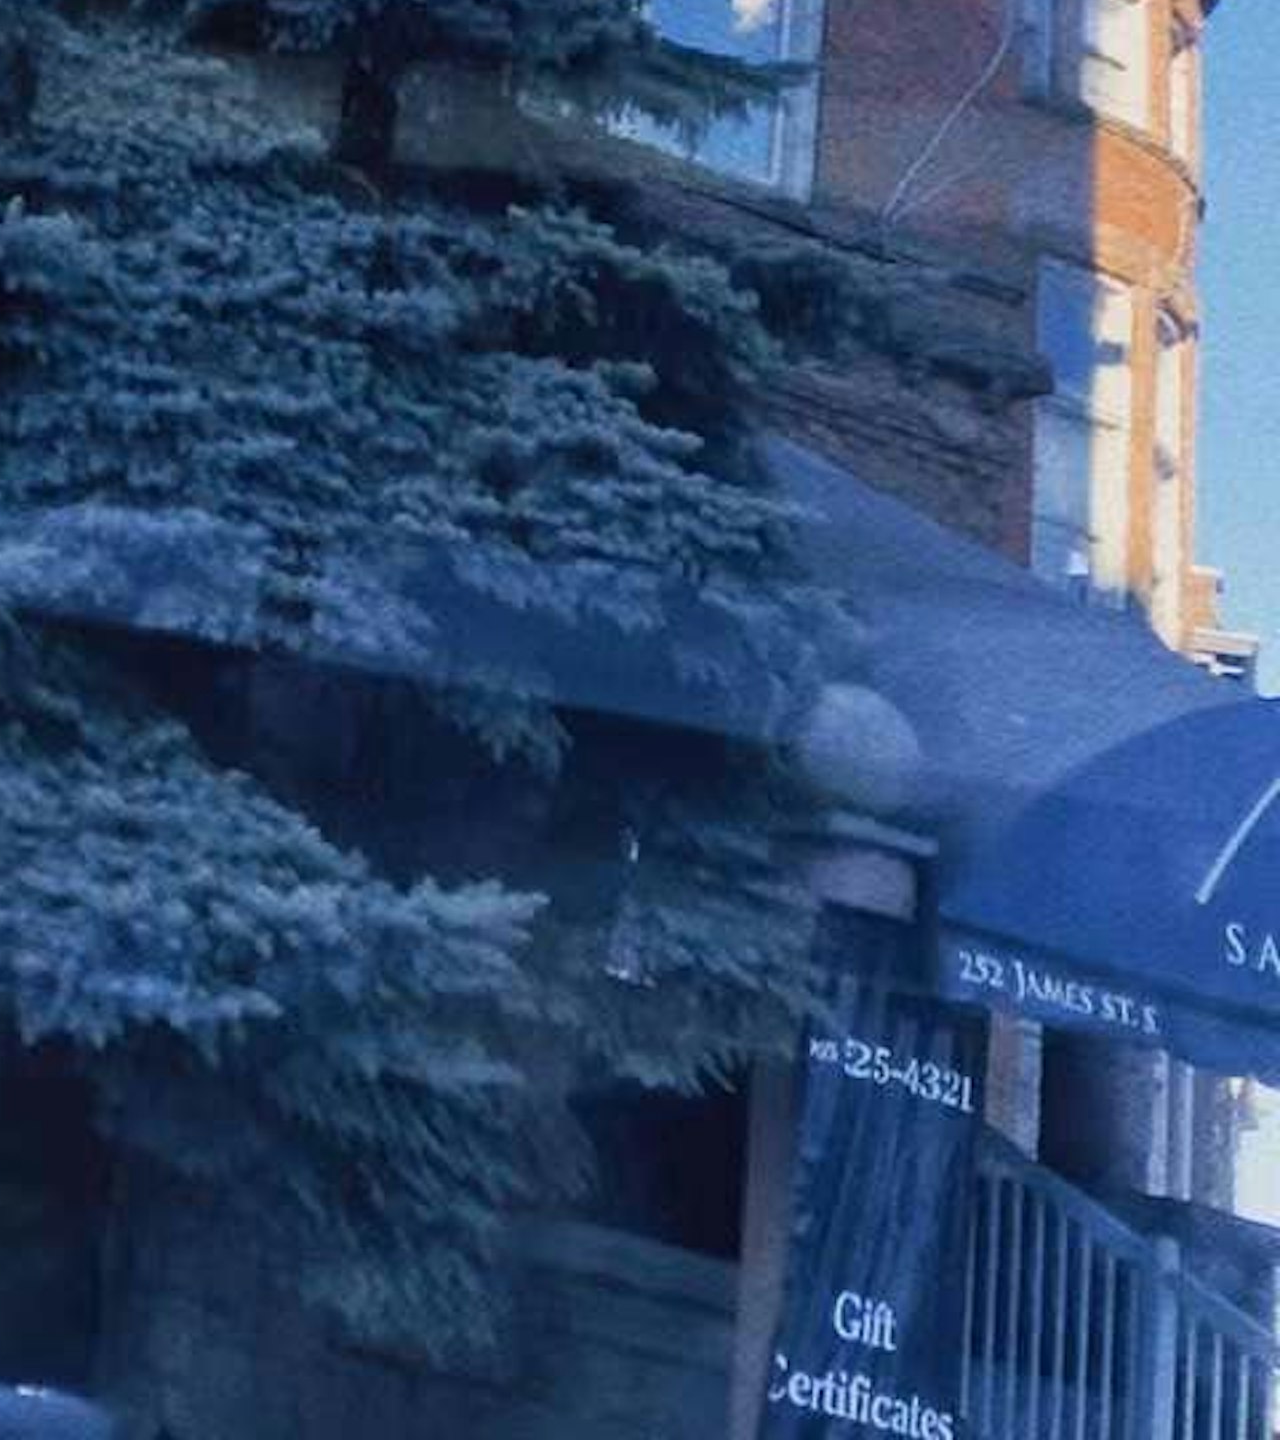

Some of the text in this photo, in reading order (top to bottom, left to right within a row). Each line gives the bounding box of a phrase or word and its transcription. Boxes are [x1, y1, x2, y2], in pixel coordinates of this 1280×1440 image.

[959, 950, 1003, 988] 252
[1013, 959, 1093, 1015] JAMES
[1101, 992, 1139, 1027] ST.
[833, 1290, 897, 1351] Gift
